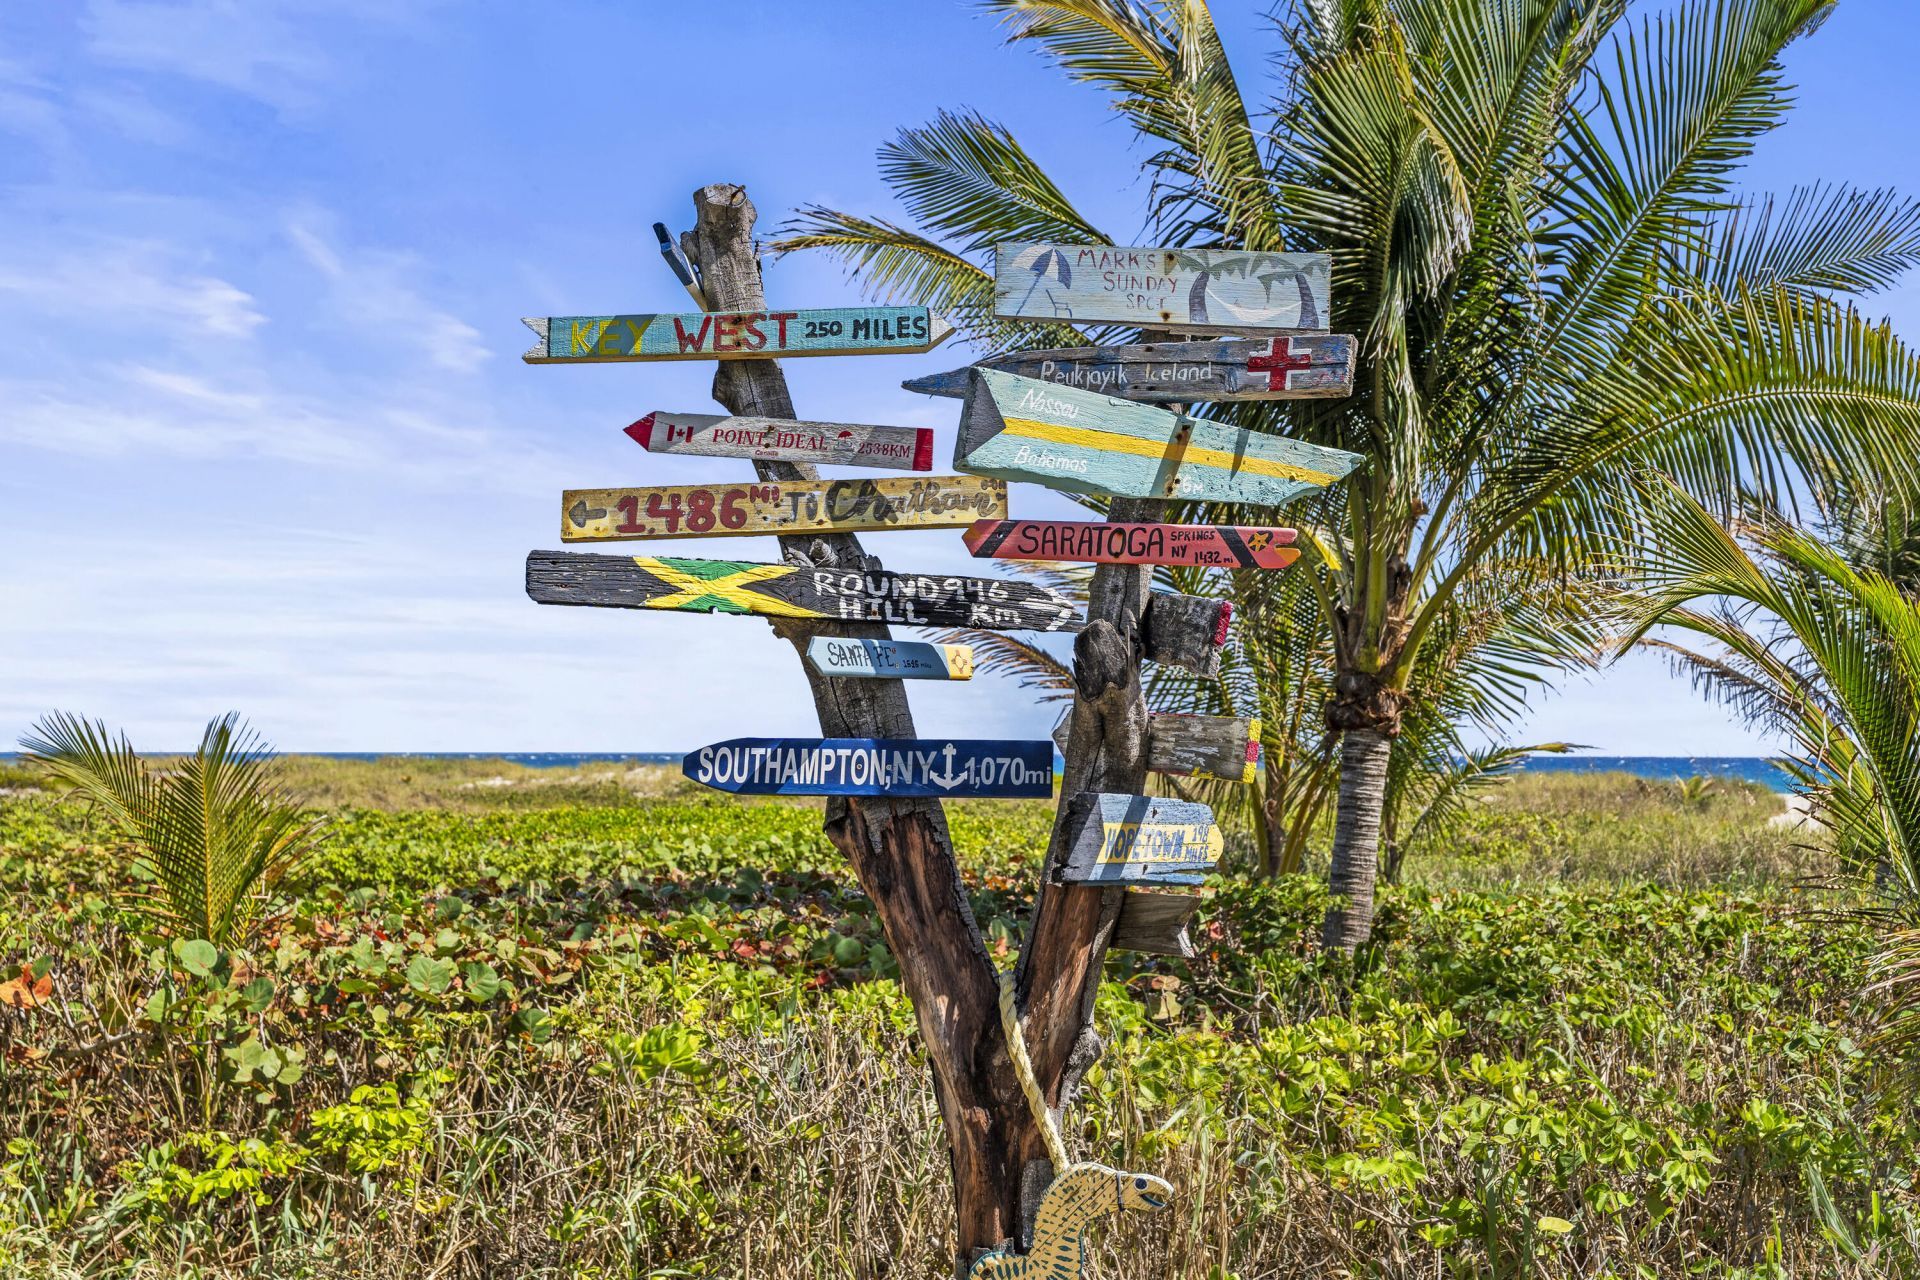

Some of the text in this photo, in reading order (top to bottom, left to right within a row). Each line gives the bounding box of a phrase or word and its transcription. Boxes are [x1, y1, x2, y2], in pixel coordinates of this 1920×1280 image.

[1078, 249, 1156, 270] MARK'S
[1103, 270, 1177, 293] SUNDAY
[571, 312, 927, 354] KEY WEST 250 MILES
[1145, 361, 1212, 382] Iceland
[712, 429, 766, 446] POINT
[776, 432, 828, 450] IDEAL
[1014, 445, 1088, 474] Bahamas
[1018, 525, 1215, 558] SARATOGA SPRINGS
[1171, 545, 1187, 558] NY
[1194, 551, 1222, 563] 1432
[813, 572, 1008, 602] ROUND 946
[839, 596, 928, 624] HILL
[827, 642, 873, 667] SANTA
[873, 646, 894, 667] FE
